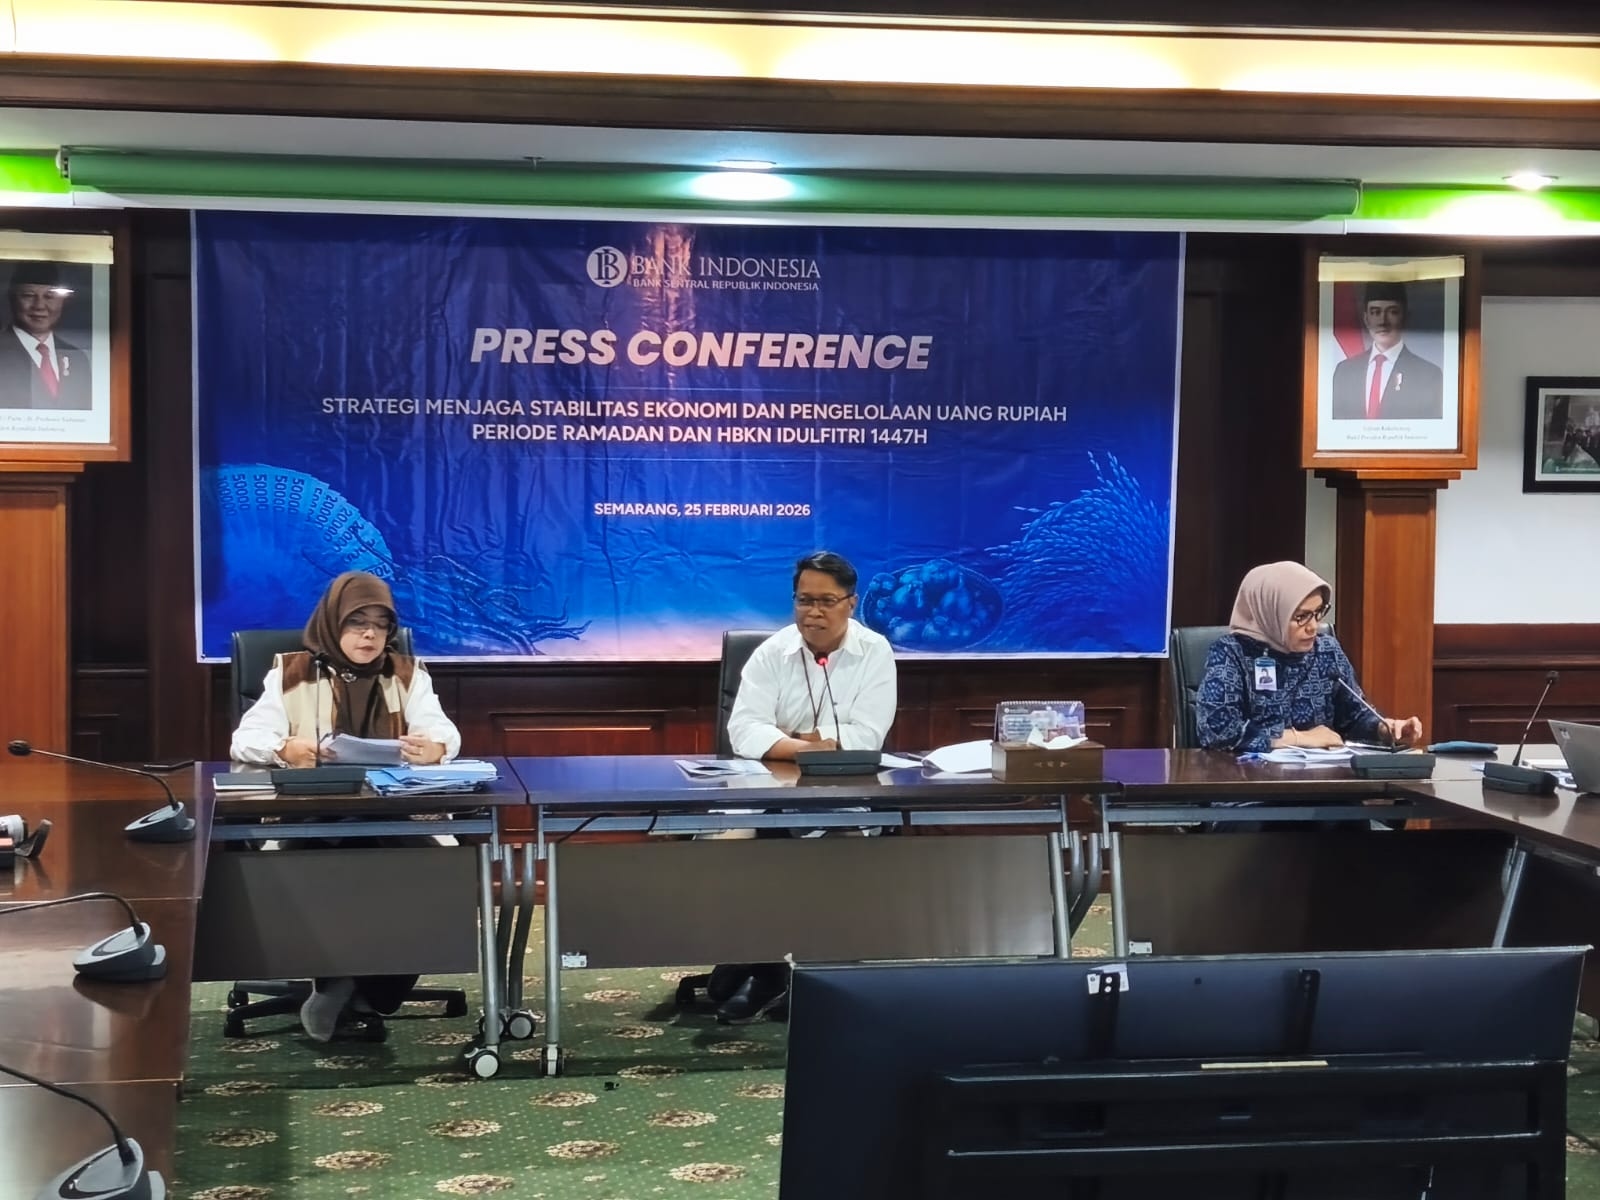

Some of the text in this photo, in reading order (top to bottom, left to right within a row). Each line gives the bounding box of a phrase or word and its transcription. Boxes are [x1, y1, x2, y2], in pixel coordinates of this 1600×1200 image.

[631, 255, 821, 278] BANK INDONESIA
[633, 278, 661, 288] BANK
[712, 280, 761, 290] REPUBLIK
[763, 281, 819, 291] INDONESIA
[470, 327, 933, 370] PRESS CONFERENCE
[322, 398, 1067, 422] STRATEGI MENJAGA STABILITAS EKONOMI DAN PENGELOLAAN UANG RUPIAH
[473, 424, 928, 444] PERIODE RAMADAN DAN HBKN IDULFITRI 1447H
[594, 503, 811, 517] SEMARANG, 25 FEBRUARI 2026
